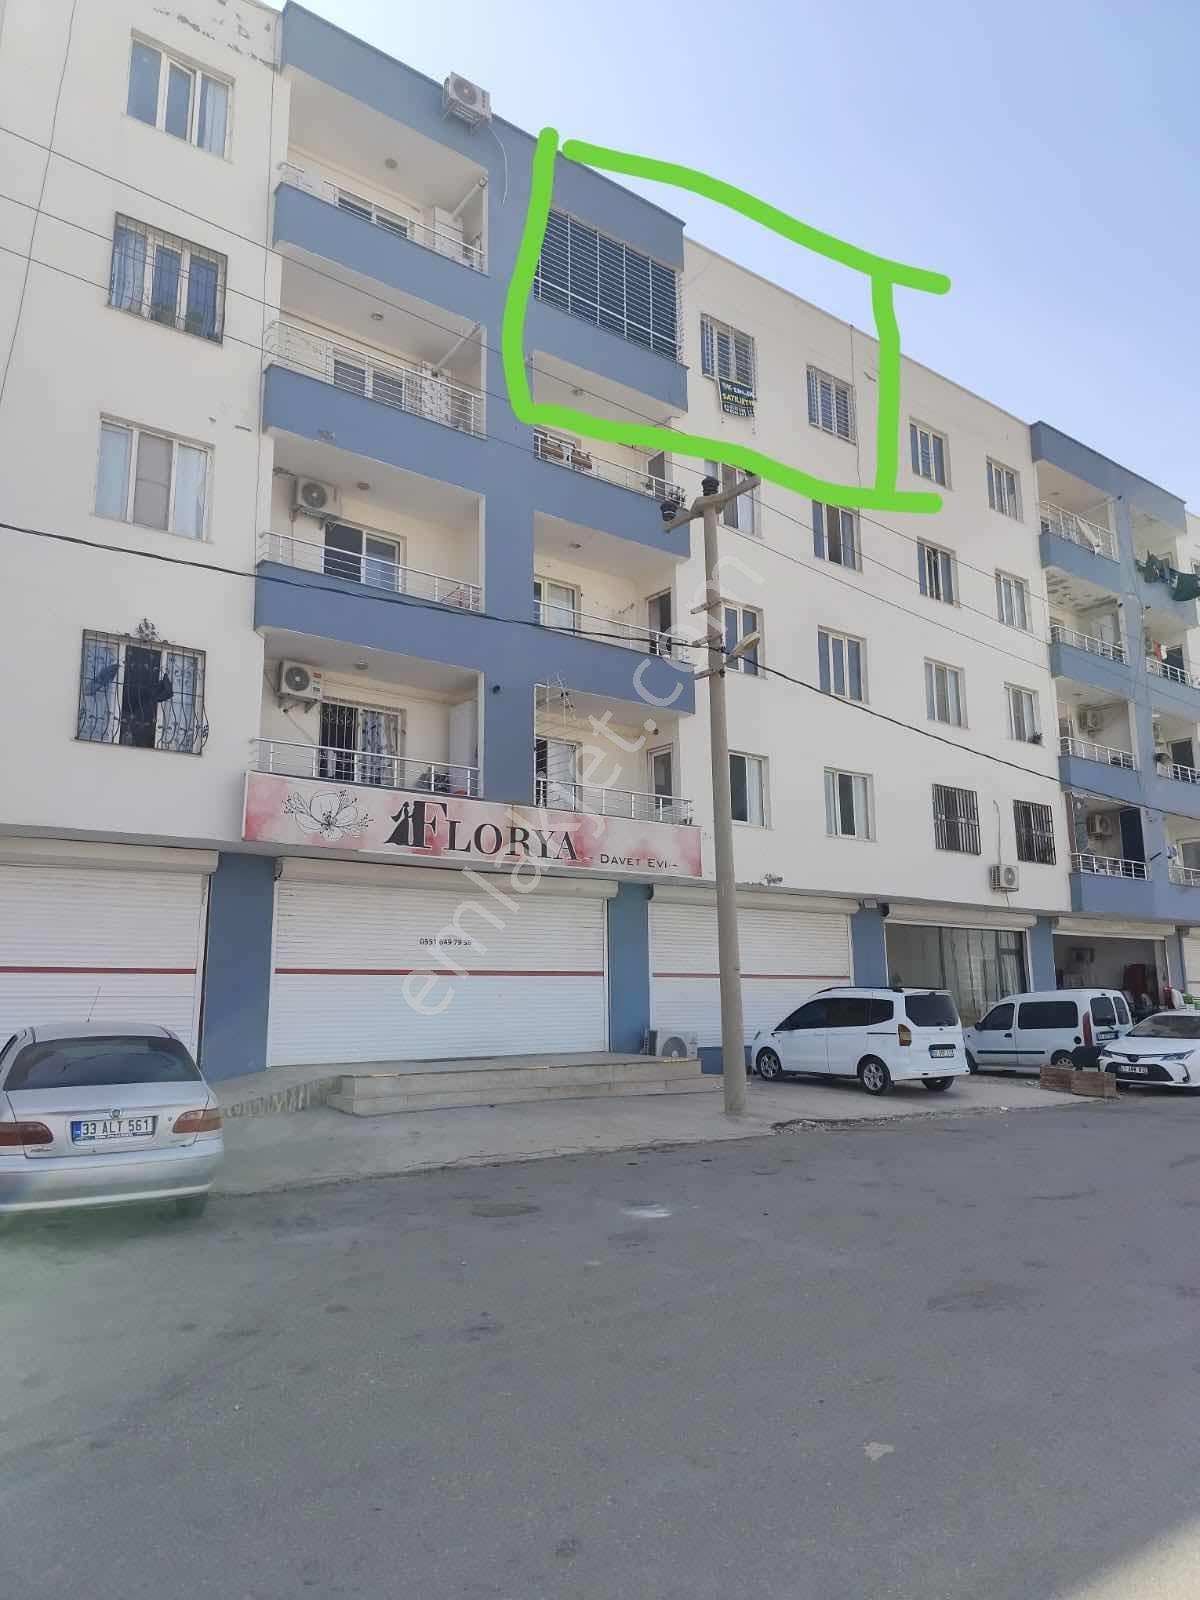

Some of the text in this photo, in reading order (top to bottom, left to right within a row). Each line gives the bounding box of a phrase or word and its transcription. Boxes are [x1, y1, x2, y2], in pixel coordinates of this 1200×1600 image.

[412, 800, 578, 861] FLORYA
[82, 1122, 97, 1136] 33
[102, 1120, 124, 1134] ALT
